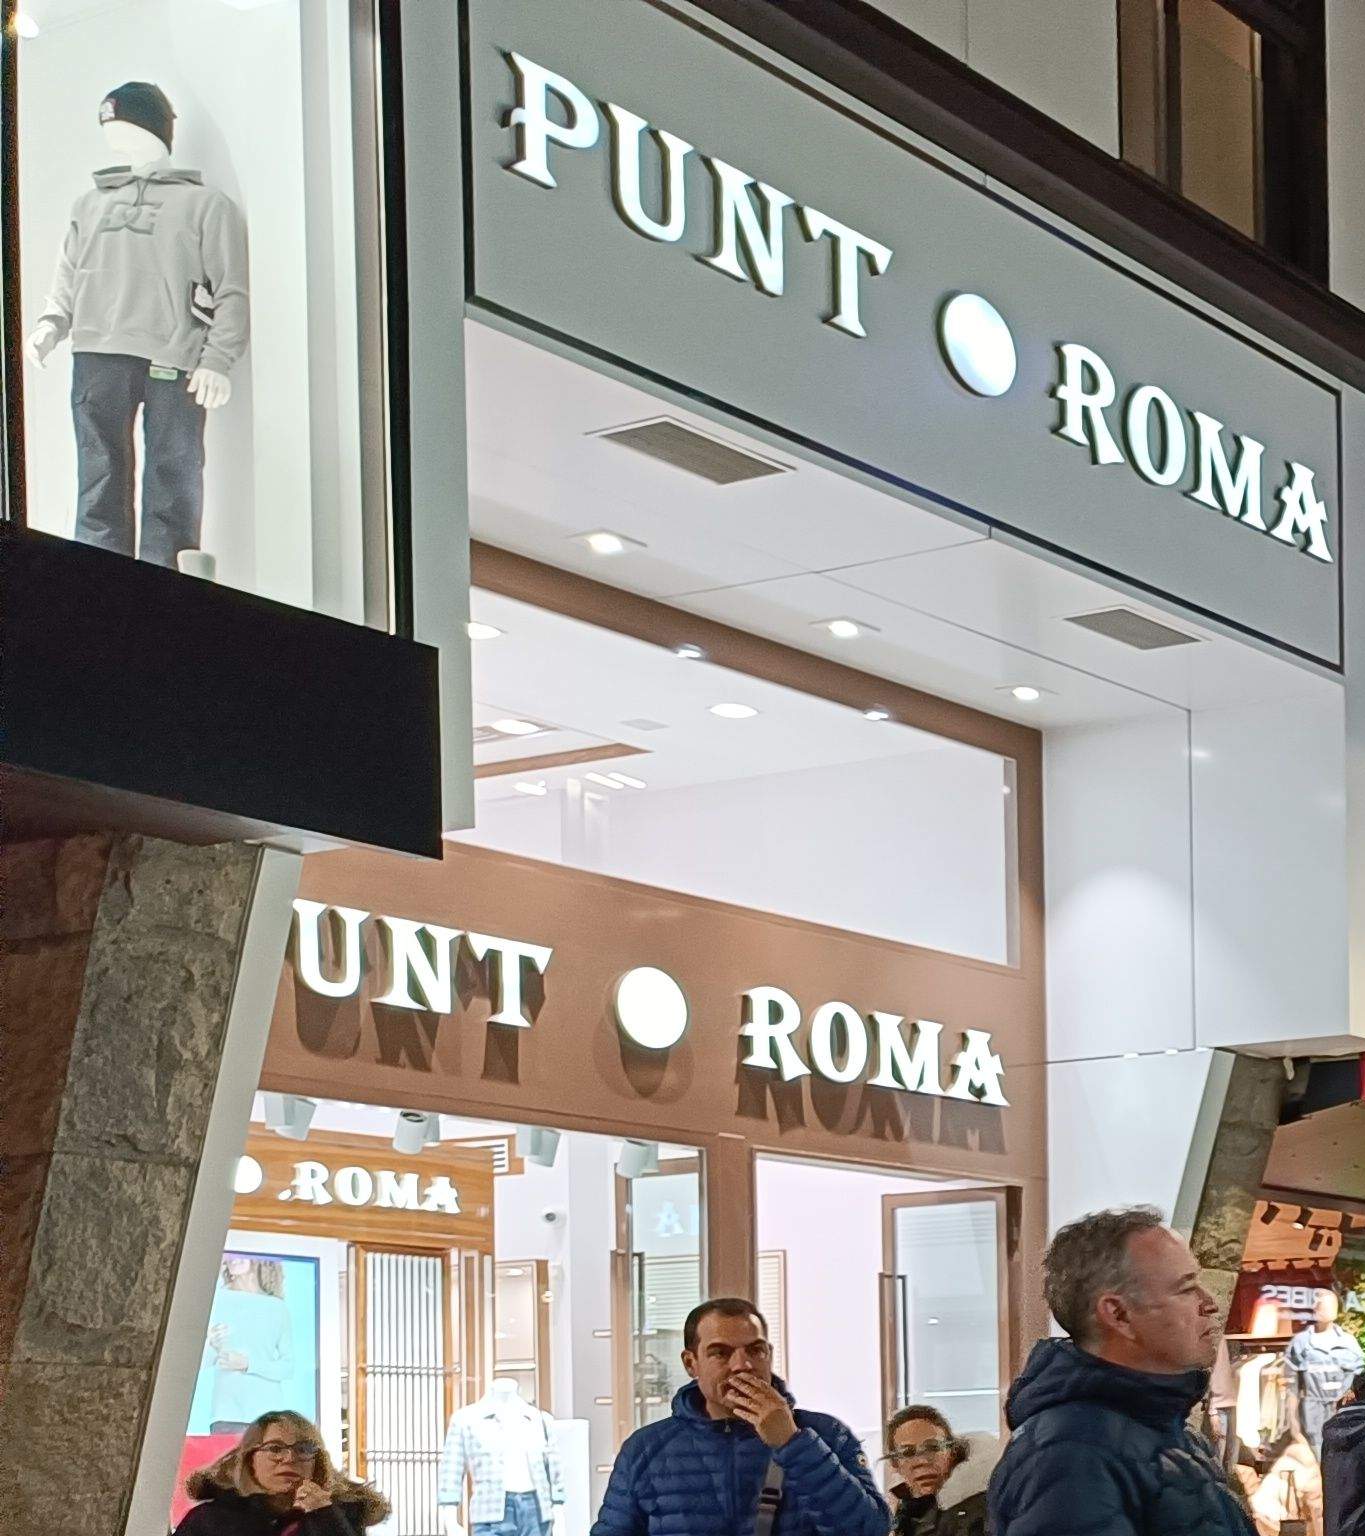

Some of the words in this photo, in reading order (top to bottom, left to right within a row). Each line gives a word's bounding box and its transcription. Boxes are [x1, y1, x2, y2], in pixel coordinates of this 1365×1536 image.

[505, 50, 892, 339] PUNT
[1054, 342, 1335, 564] ROMA
[293, 898, 553, 1028] UNT
[738, 986, 1011, 1107] ROMA
[288, 1160, 462, 1214] ROMA
